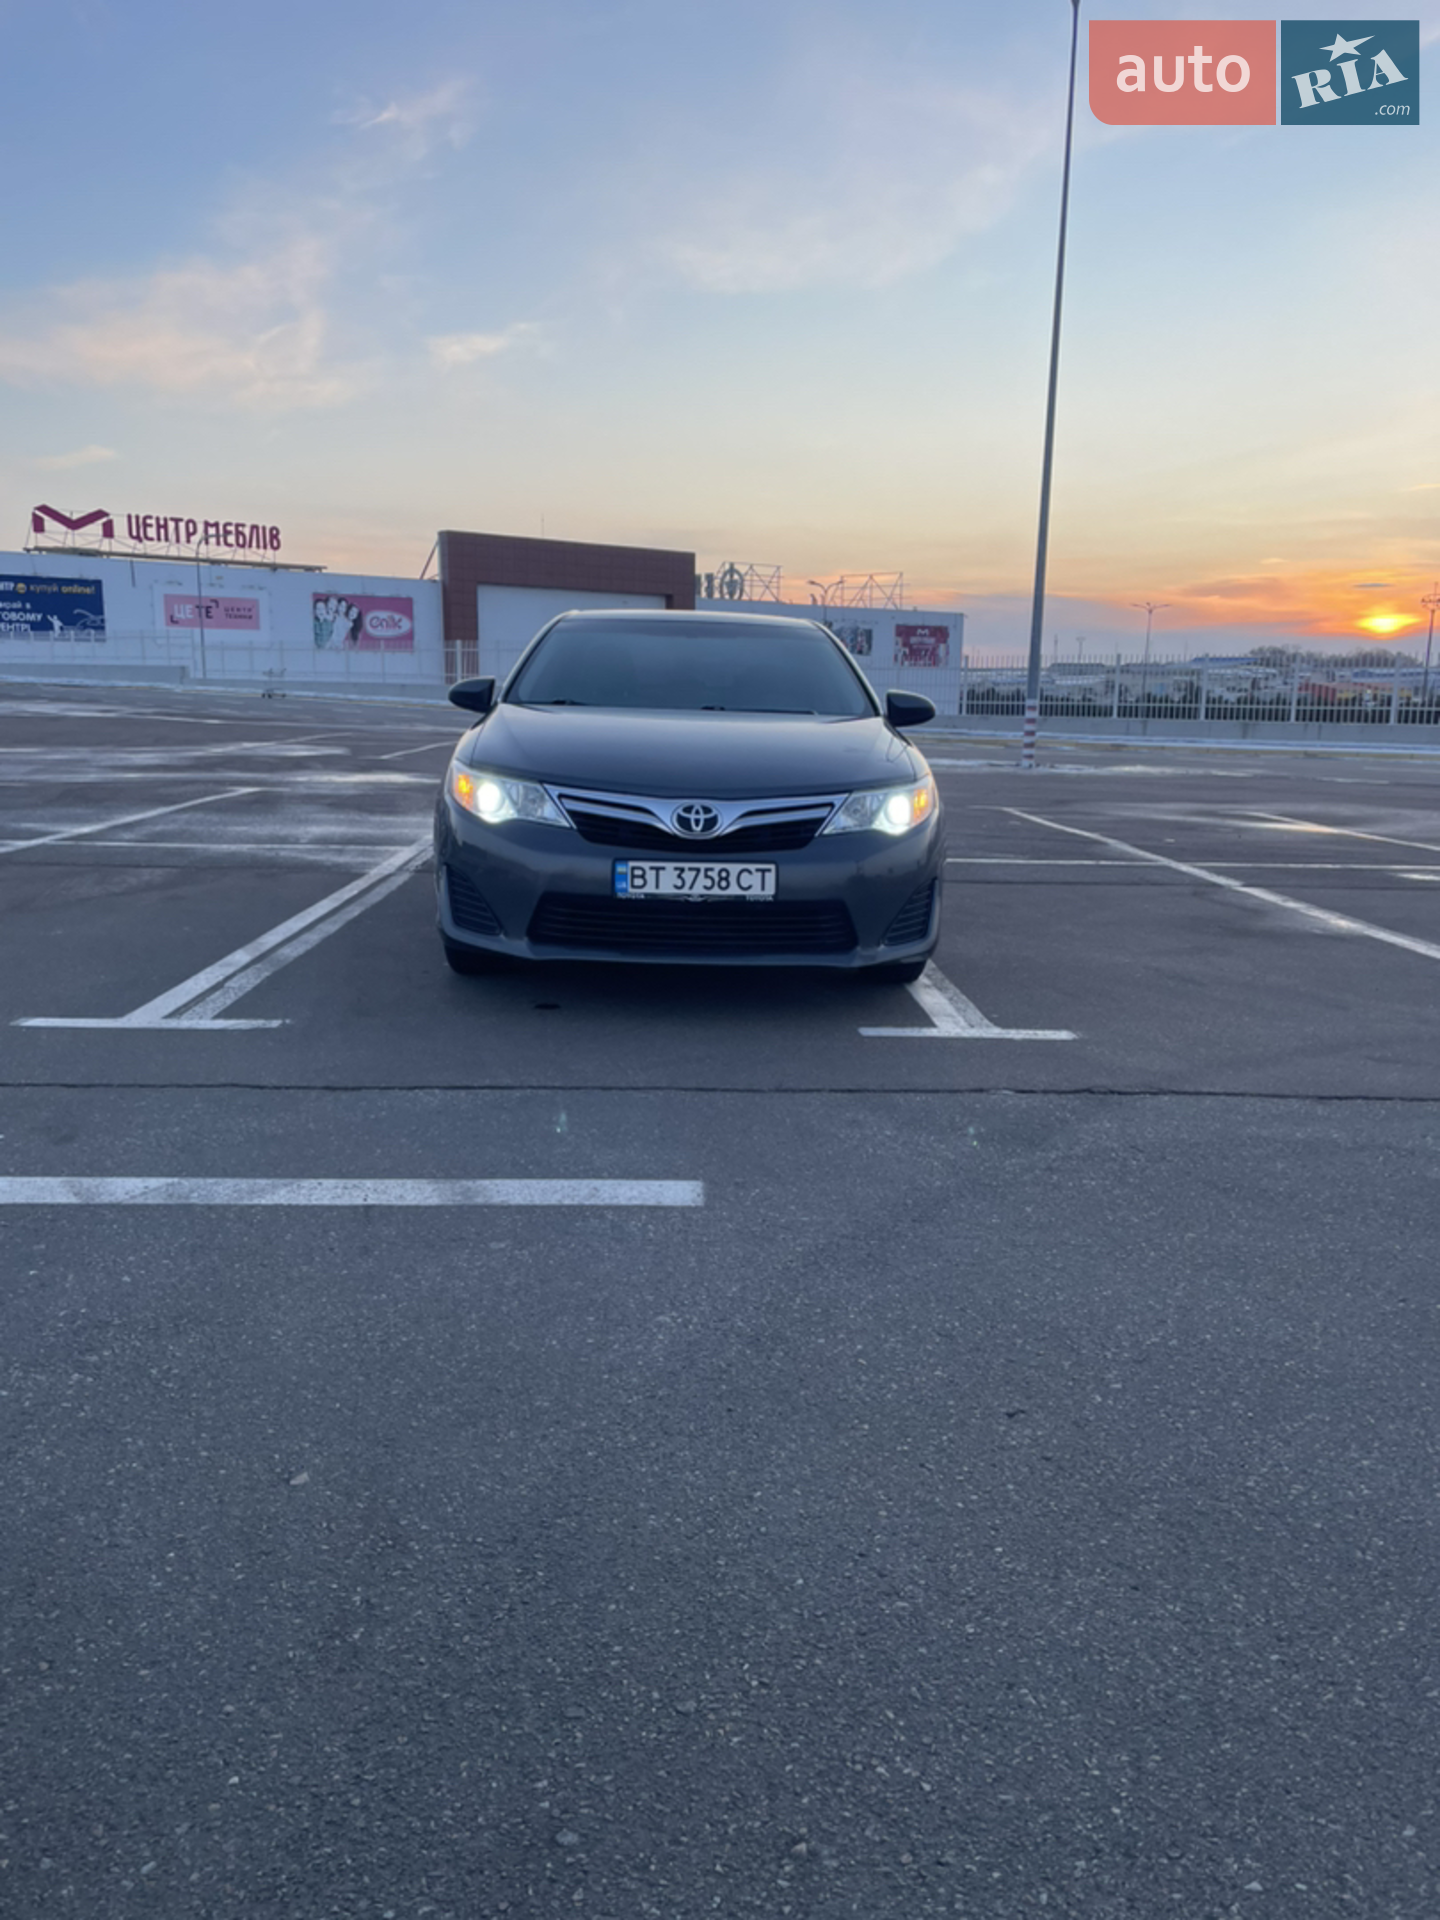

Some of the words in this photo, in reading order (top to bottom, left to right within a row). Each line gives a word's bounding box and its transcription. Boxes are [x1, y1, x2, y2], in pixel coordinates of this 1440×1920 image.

[126, 513, 198, 544] ЦЕНТР
[203, 520, 282, 551] МЕБЛІВ
[0, 622, 31, 632] ЕНТРІ
[630, 866, 666, 890] BT
[673, 867, 731, 891] 3758
[736, 868, 772, 892] CT
